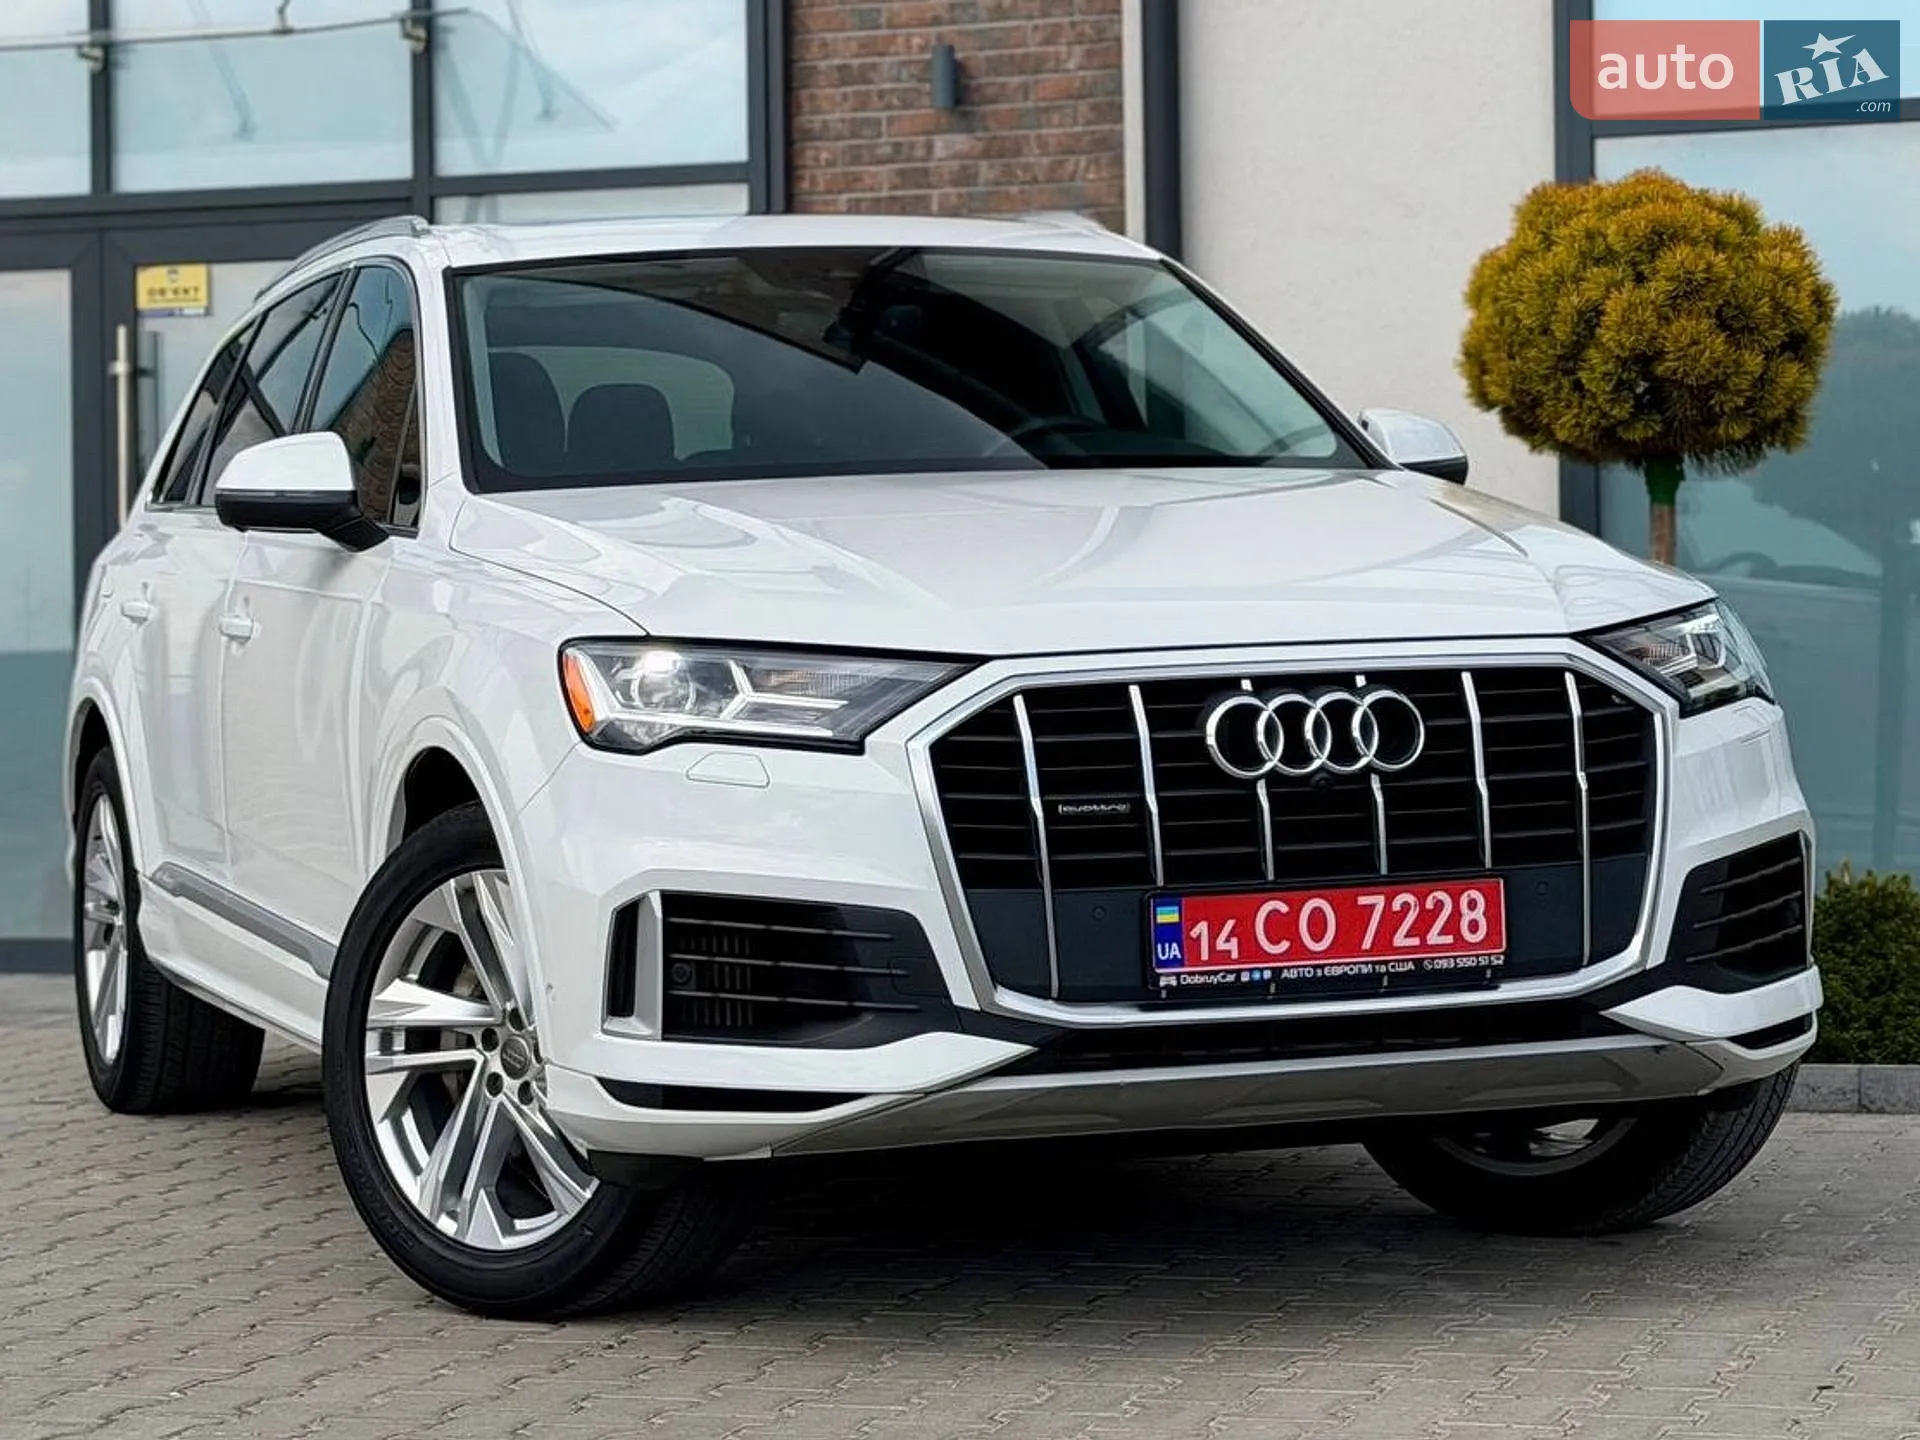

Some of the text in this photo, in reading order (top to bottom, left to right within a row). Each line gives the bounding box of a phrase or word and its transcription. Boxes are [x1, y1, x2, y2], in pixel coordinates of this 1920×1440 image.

[1189, 889, 1488, 961] 14 CO 7228
[1157, 942, 1182, 961] UA
[1179, 971, 1237, 985] DobruyCar
[1280, 967, 1315, 980] АВТО
[1323, 963, 1373, 977] ЄВРОПИ
[1387, 960, 1416, 973] США
[1433, 957, 1455, 970] 093
[1456, 956, 1478, 968] 550
